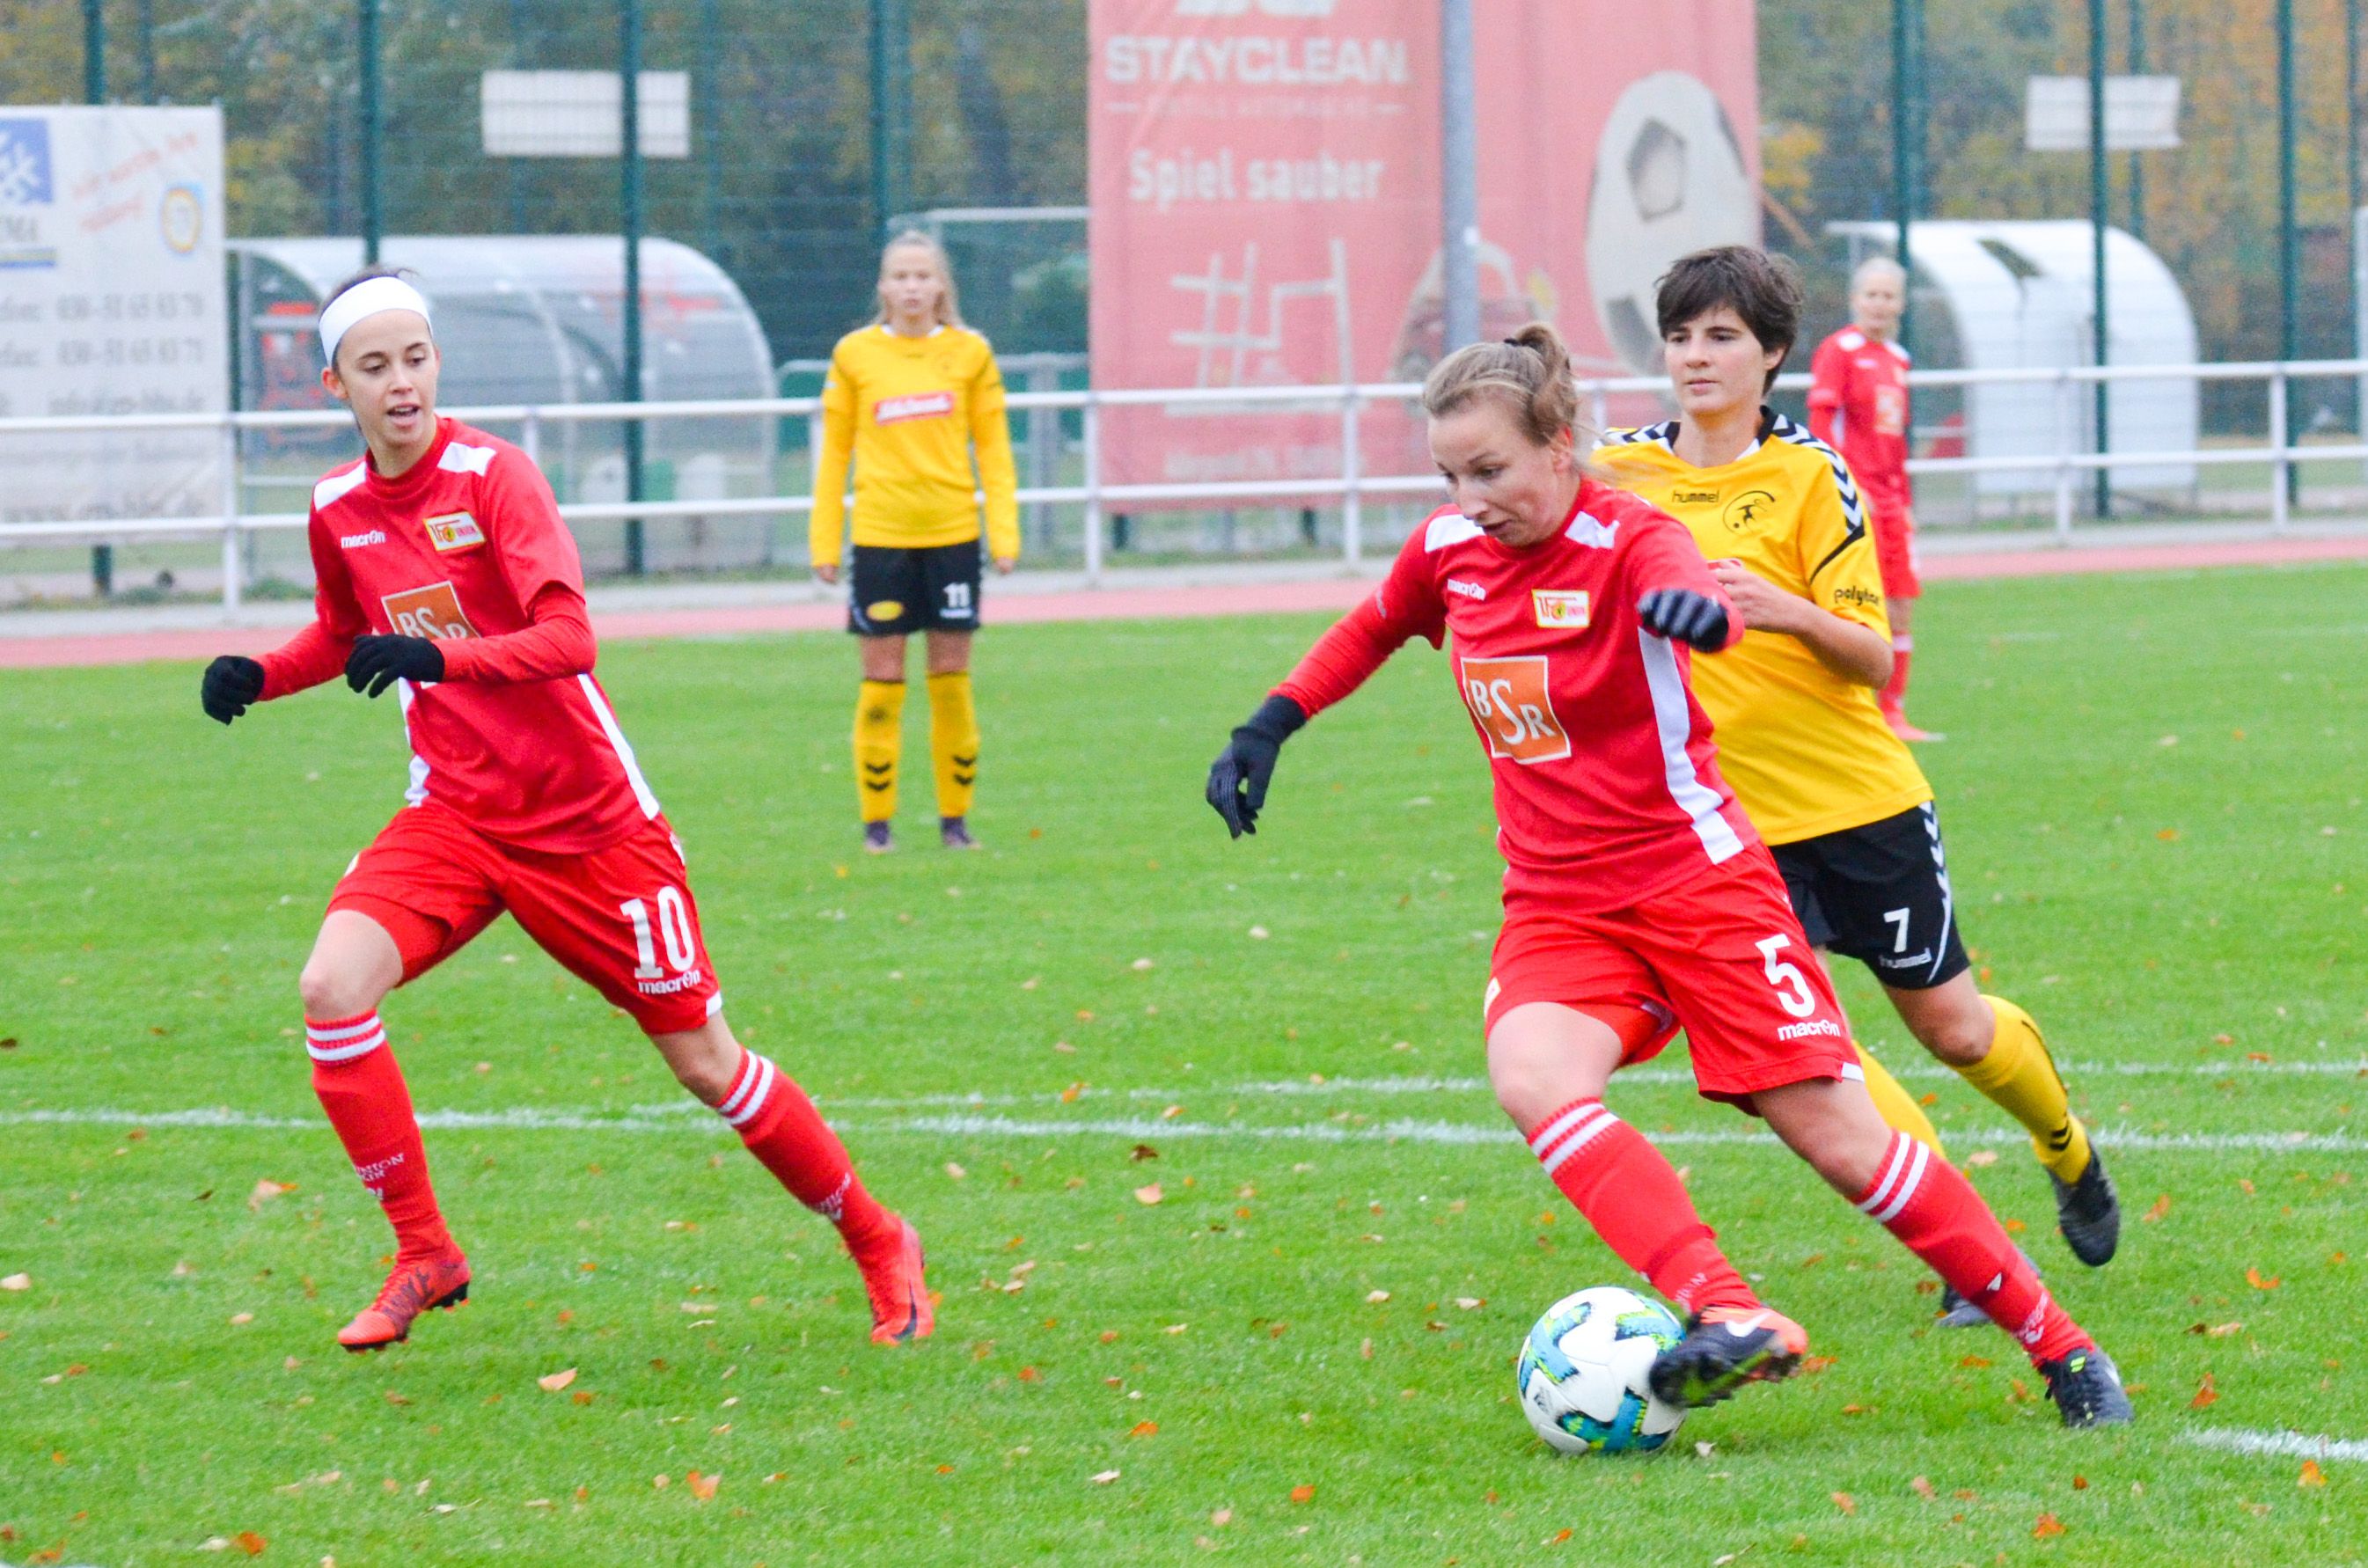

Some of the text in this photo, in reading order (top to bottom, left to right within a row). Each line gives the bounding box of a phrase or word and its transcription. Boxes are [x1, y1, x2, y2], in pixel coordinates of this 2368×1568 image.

[1105, 36, 1406, 84] STAYCLEAN
[1130, 148, 1384, 209] Spiel sauber
[1672, 489, 1719, 503] hummel
[341, 530, 385, 549] macron
[943, 583, 971, 608] 11
[1469, 678, 1556, 745] BSR
[619, 885, 695, 978] 10
[1883, 907, 1910, 953] 7
[638, 970, 701, 994] macron
[1755, 933, 1815, 1018] 5
[1778, 1019, 1841, 1041] macron
